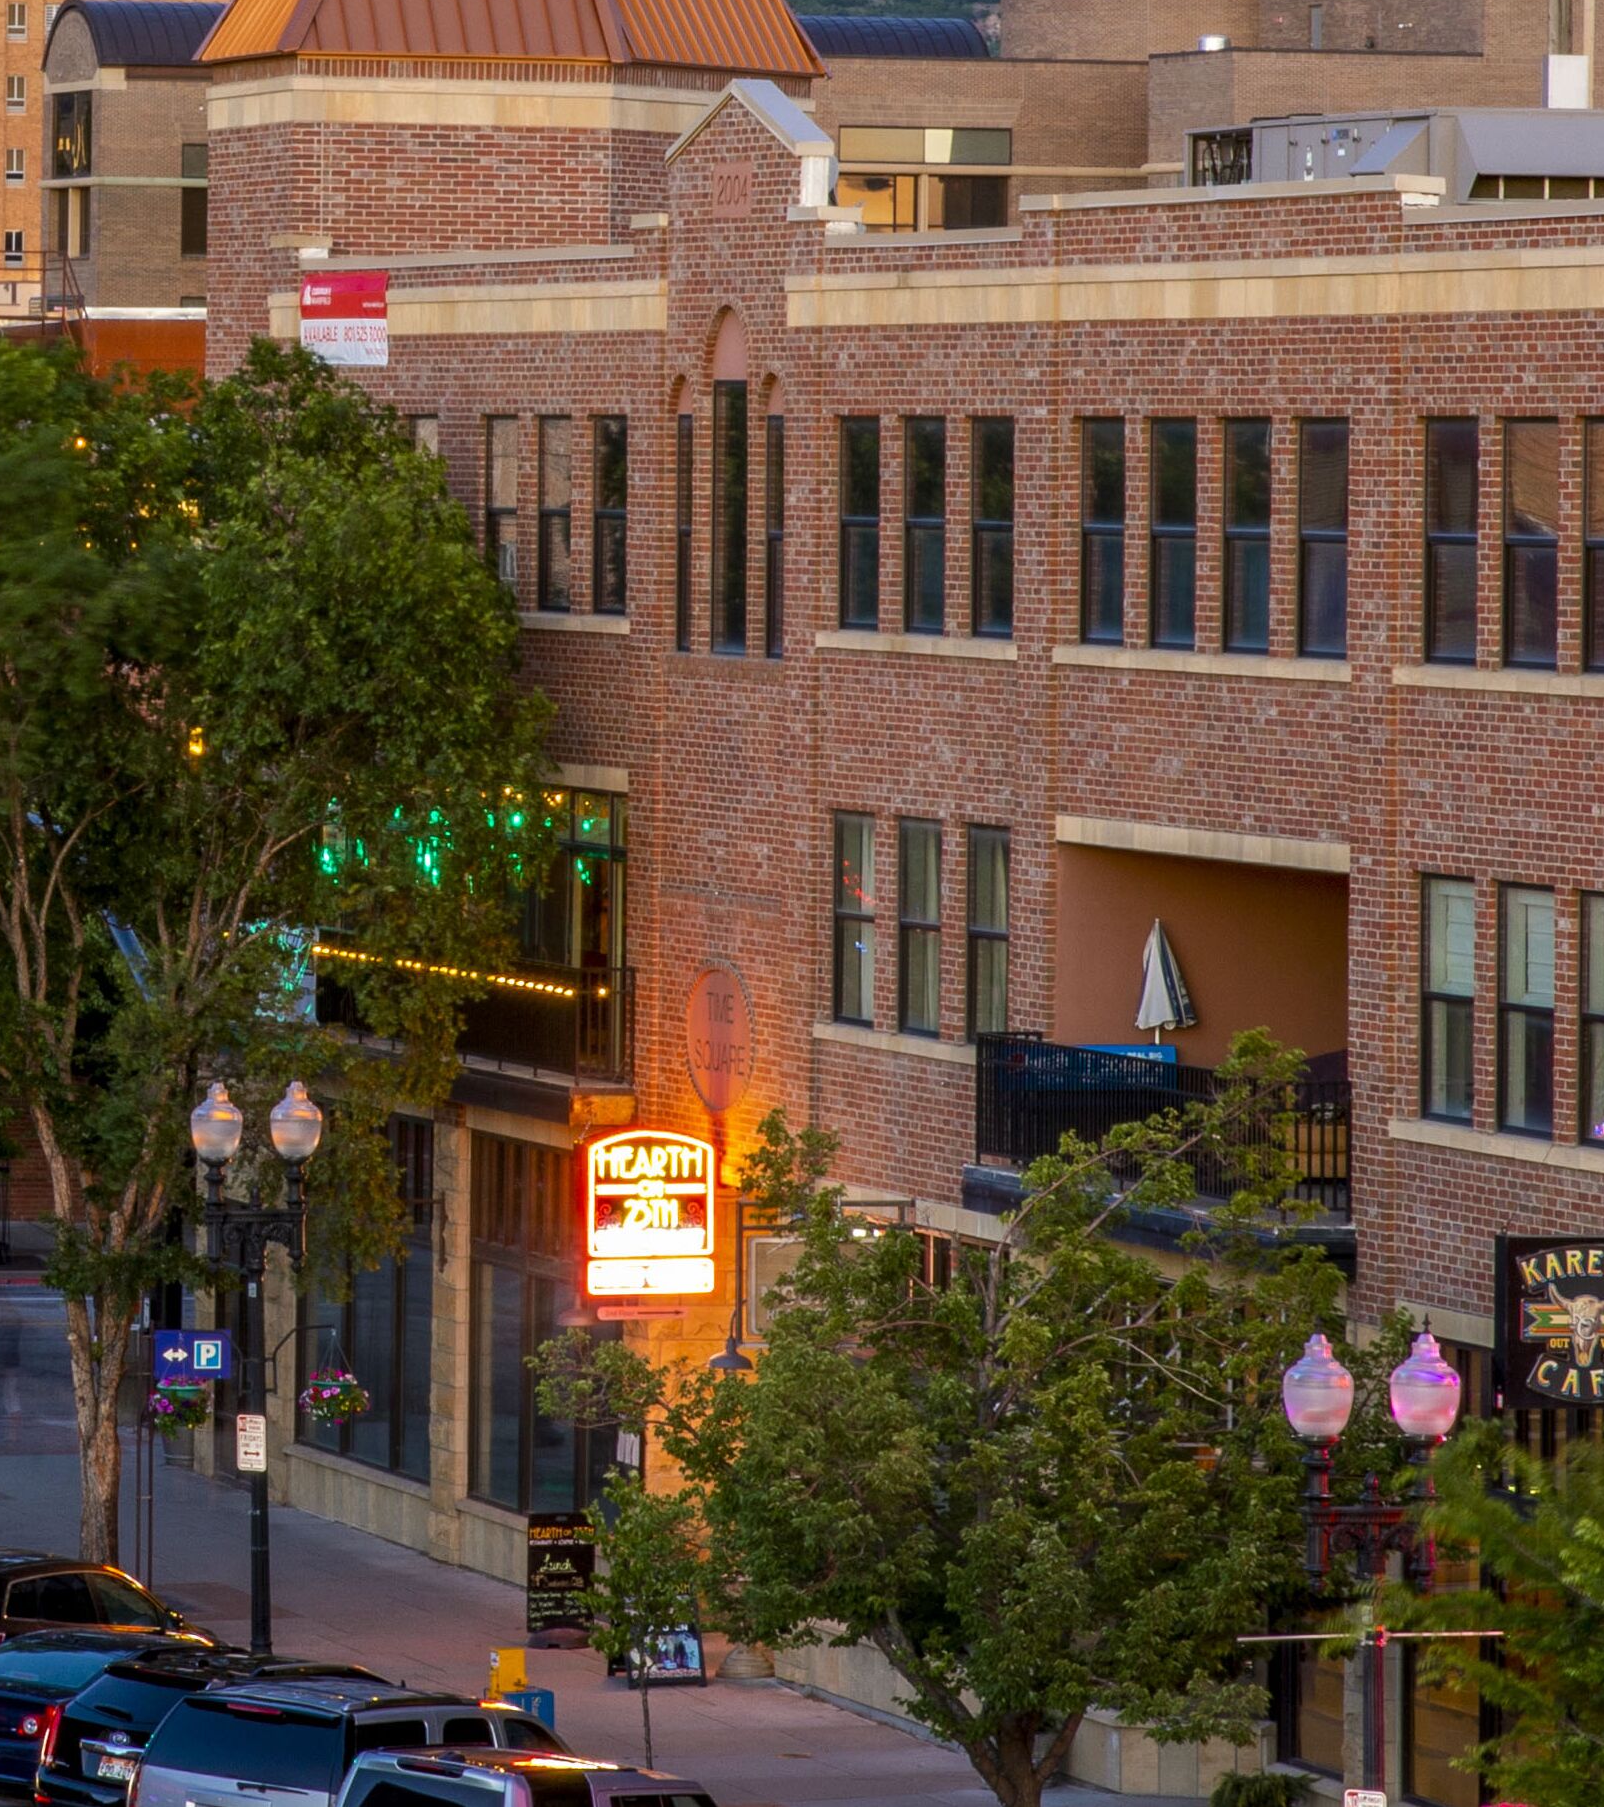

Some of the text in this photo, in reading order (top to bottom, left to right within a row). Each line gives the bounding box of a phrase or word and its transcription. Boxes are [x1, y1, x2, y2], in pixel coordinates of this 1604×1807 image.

[718, 175, 747, 205] 2004
[304, 325, 337, 343] AVAILABLE
[706, 991, 734, 1024] TIME
[695, 1038, 745, 1076] SQUARE
[595, 1145, 703, 1180] HEARTH
[1549, 1338, 1570, 1349] OUT
[200, 1344, 217, 1366] P
[530, 1527, 562, 1539] HEARTH
[539, 1553, 572, 1572] Lunch
